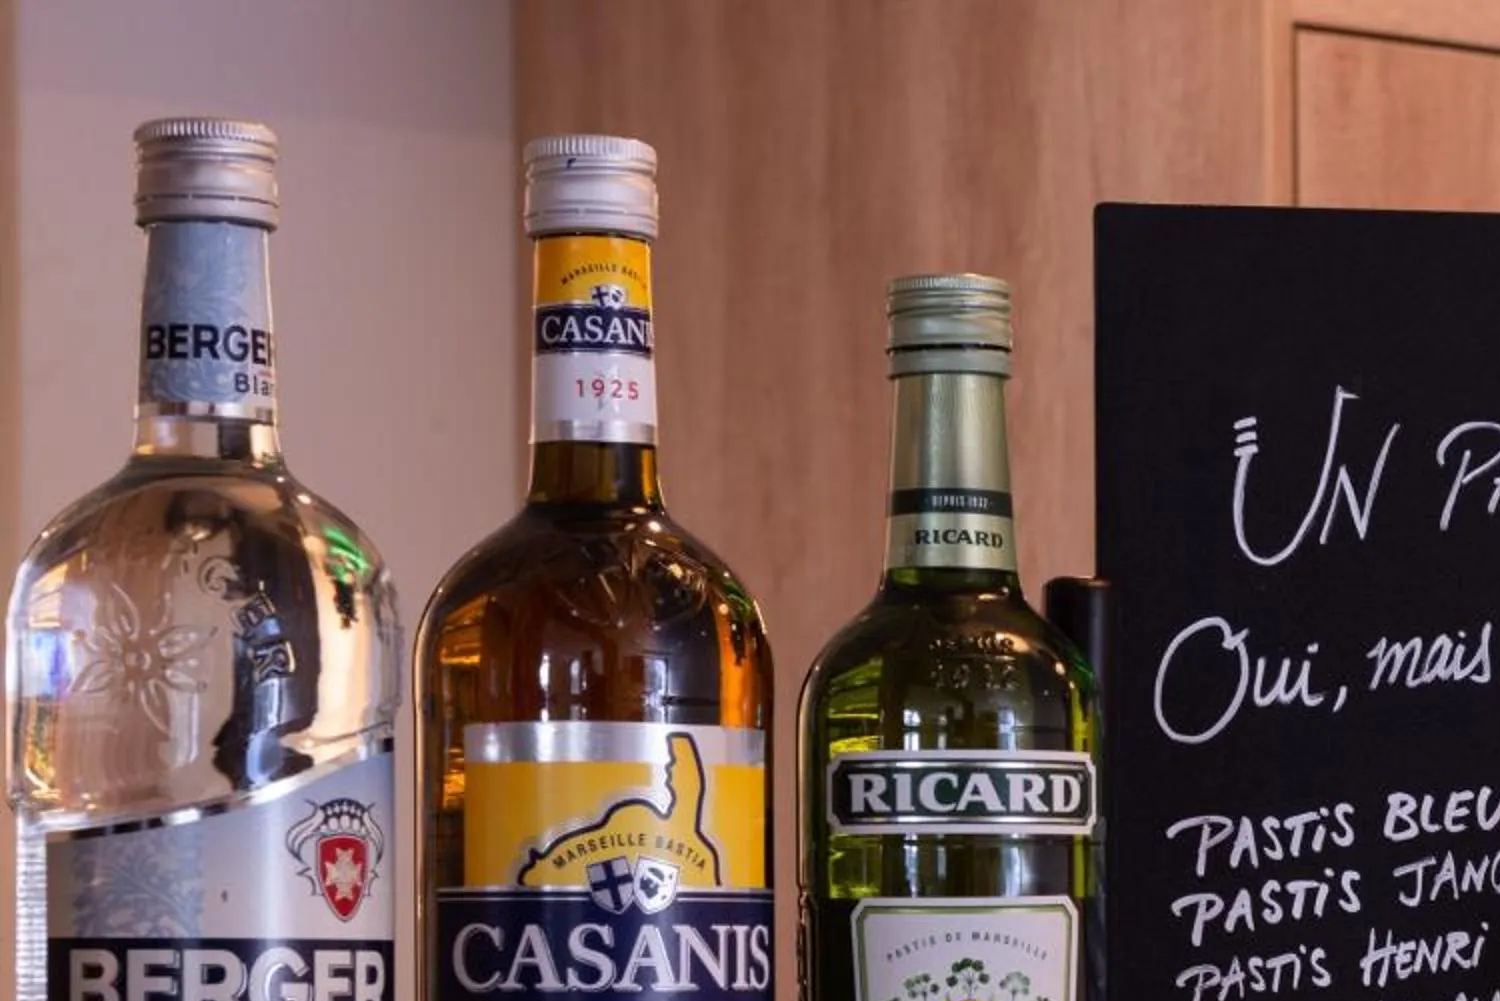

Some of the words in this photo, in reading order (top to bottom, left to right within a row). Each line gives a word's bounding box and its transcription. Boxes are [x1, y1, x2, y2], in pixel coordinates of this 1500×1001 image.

[575, 378, 639, 400] 1925
[1233, 384, 1401, 566] UN
[915, 529, 1003, 549] RICARD
[1368, 621, 1492, 690] mais
[848, 772, 1082, 814] RICARD
[552, 831, 647, 871] MARSEILLE
[655, 836, 707, 870] BASTIA
[452, 922, 770, 993] CASANIS
